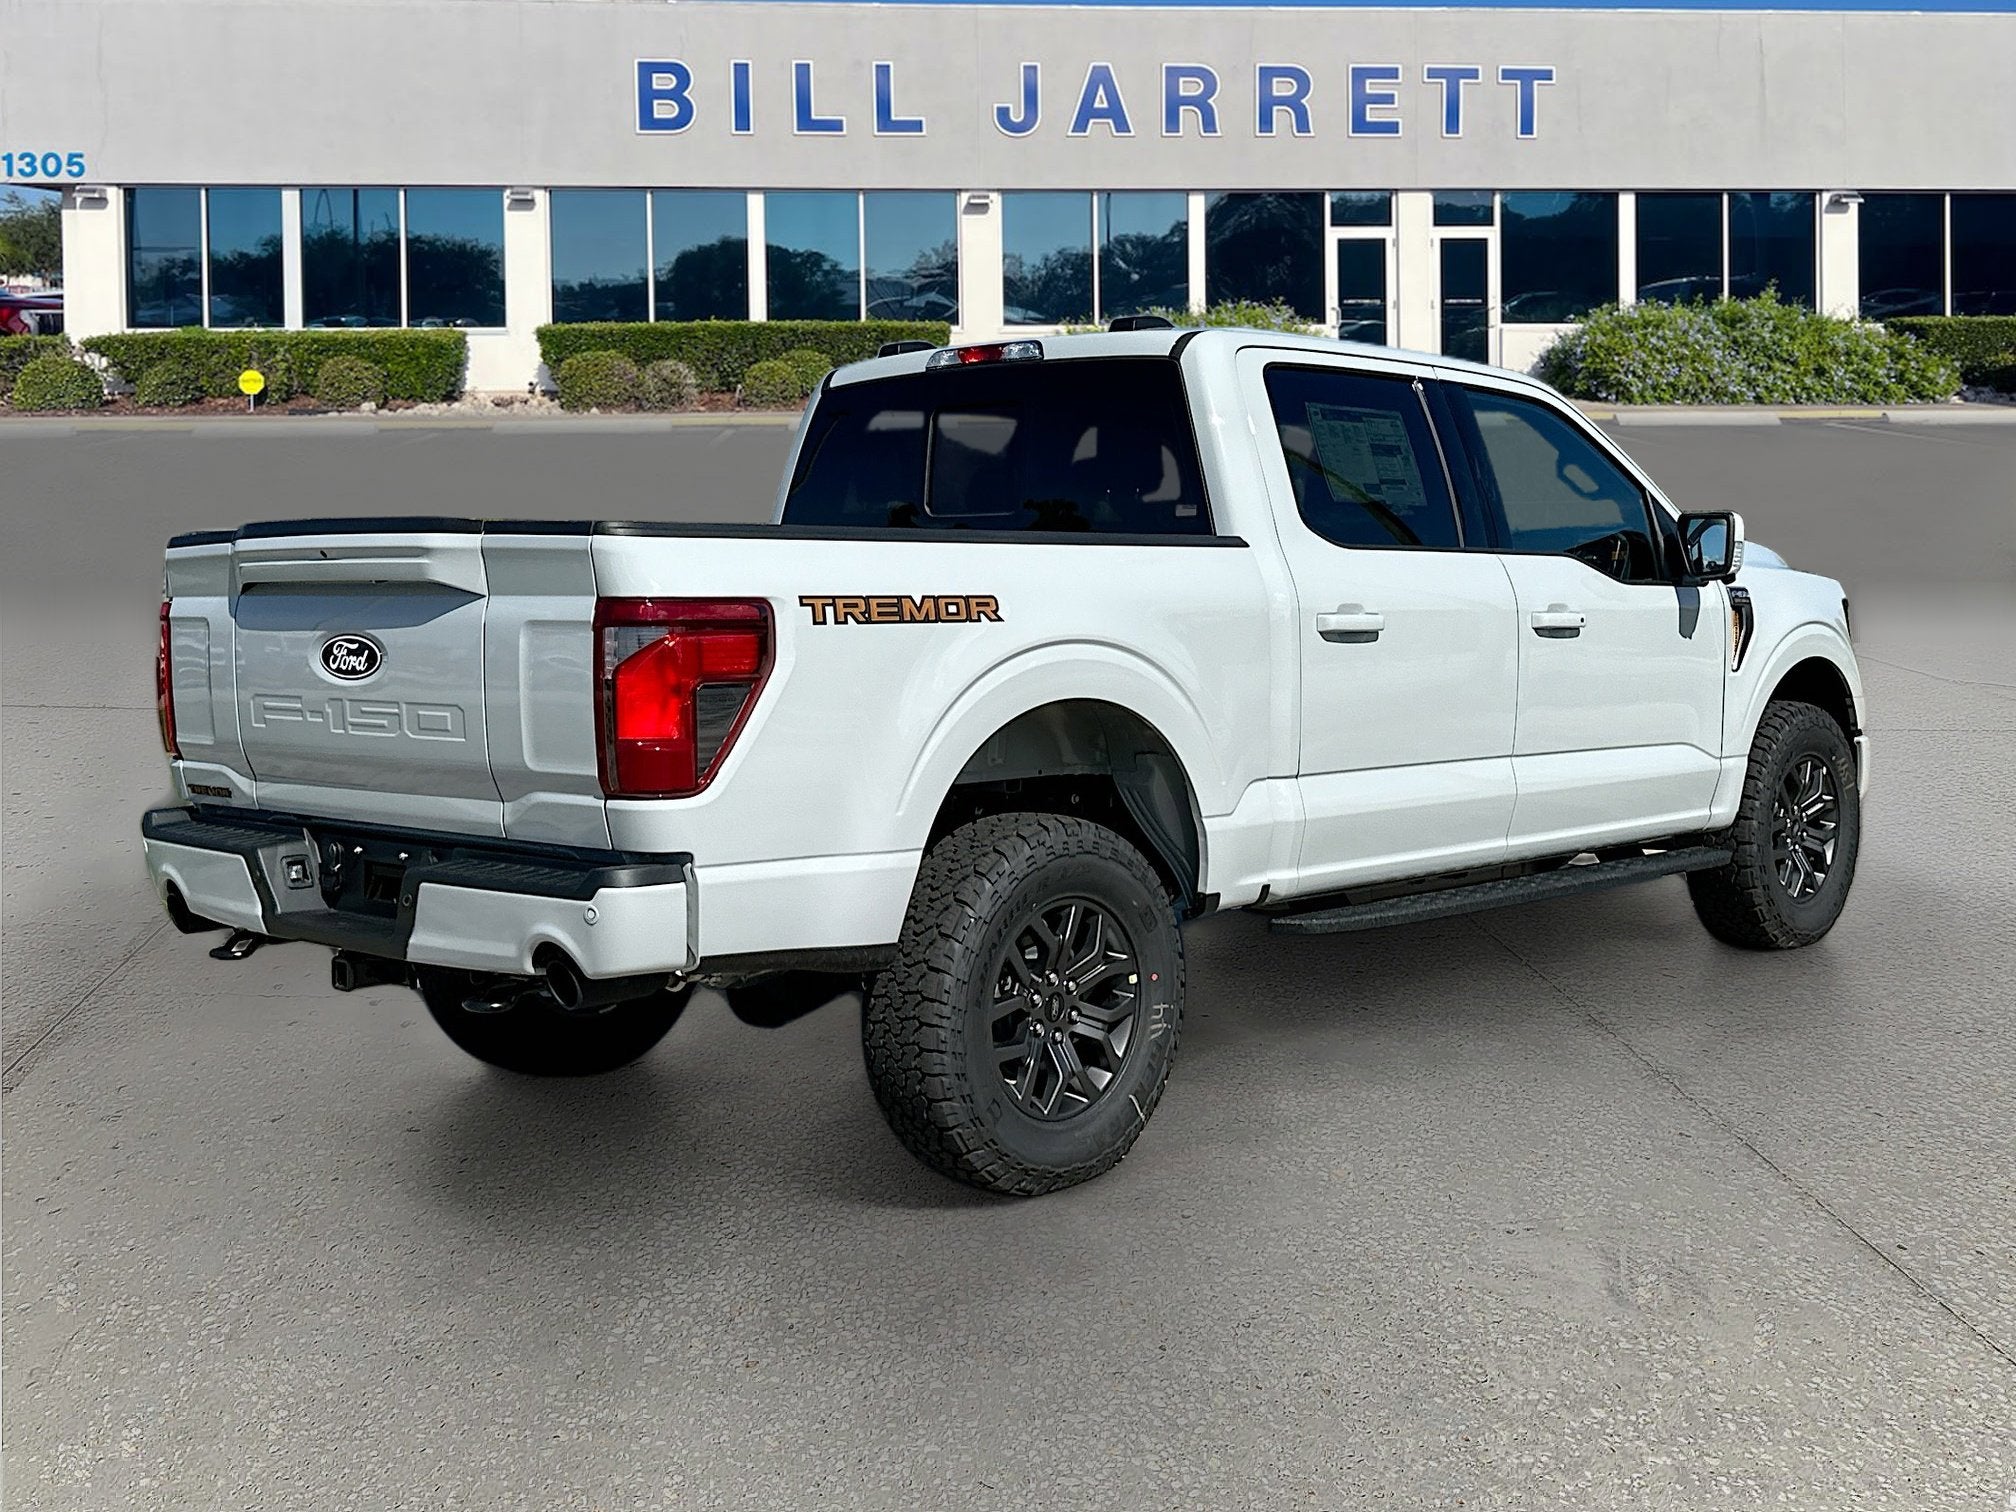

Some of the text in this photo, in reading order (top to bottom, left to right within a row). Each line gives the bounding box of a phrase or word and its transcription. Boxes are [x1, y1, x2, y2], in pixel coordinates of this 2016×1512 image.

[634, 59, 1556, 138] BILL JARRETT
[1, 151, 86, 178] 1305
[798, 595, 1005, 625] TREMOR
[329, 640, 369, 672] Ford
[250, 693, 467, 743] F-150
